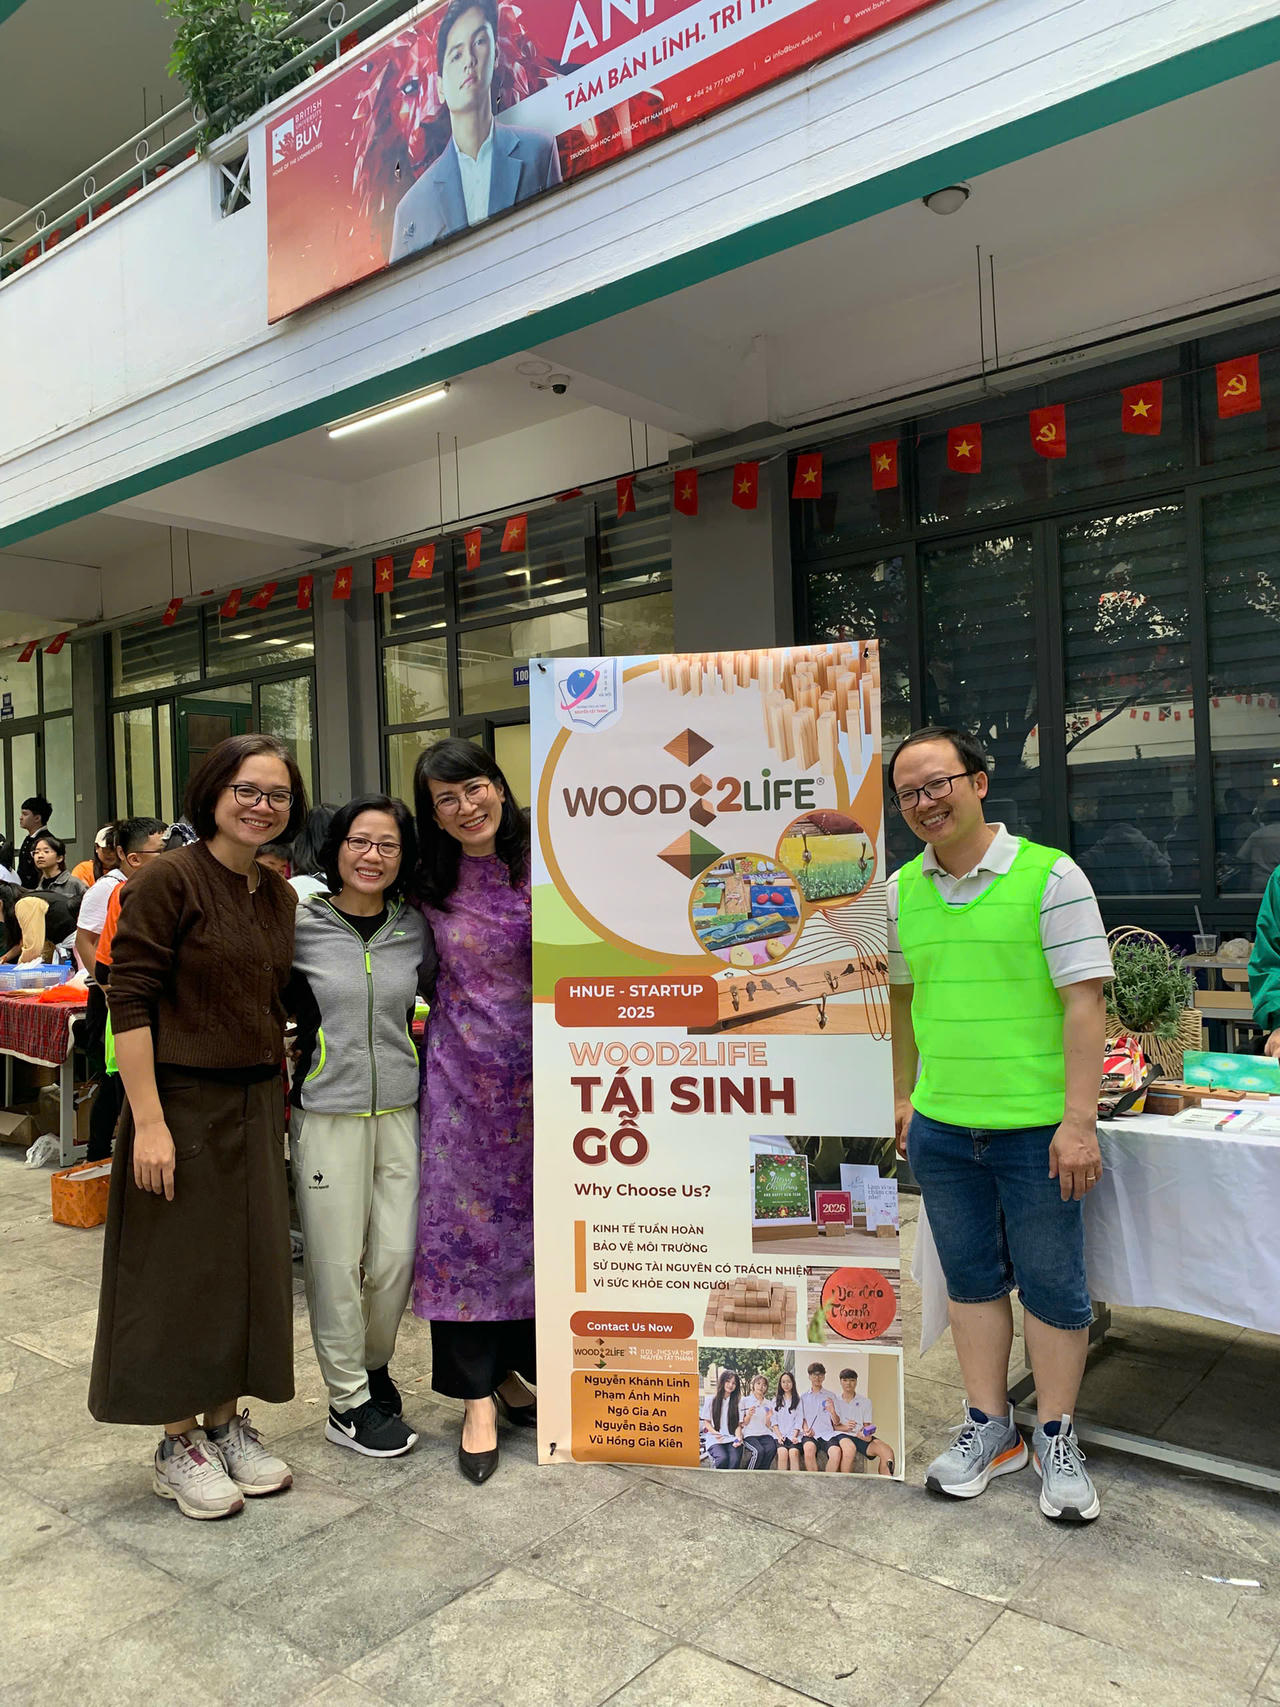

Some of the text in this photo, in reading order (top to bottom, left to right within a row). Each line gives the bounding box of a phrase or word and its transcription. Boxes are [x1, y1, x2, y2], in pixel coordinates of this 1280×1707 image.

[560, 0, 656, 66] AN
[772, 30, 822, 60] info@buv.edu.vn
[565, 75, 603, 111] TÂM
[608, 51, 647, 89] BẢN
[652, 22, 706, 66] LĨNH.
[713, 79, 724, 89] 777
[725, 73, 736, 83] 009
[295, 99, 322, 122] BRITISH
[296, 120, 322, 151] BUV
[563, 784, 687, 818] WOOD
[569, 985, 615, 998] HNUE
[629, 984, 704, 997] STARTUP
[617, 1006, 655, 1019] 2025
[568, 1041, 768, 1067] WOOD2LIFE
[570, 1066, 797, 1116] TÁI SINH
[572, 1110, 650, 1166] GỖ
[574, 1183, 711, 1199] Why Choose Us?
[823, 1203, 846, 1213] 2026
[593, 1224, 619, 1233] KINH
[622, 1222, 635, 1234] TẾ
[672, 1224, 704, 1235] HOÀN
[593, 1240, 708, 1253] BẢO VỆ MÔI TRƯỜNG
[593, 1259, 813, 1277] SỬ DỤNG TÀI NGUYÊN CÓ TRÁCH NHIỆM
[593, 1277, 730, 1290] VÌ SỨC KHỎE CON NGƯỜI
[586, 1321, 673, 1333] Contact Us Now
[574, 1348, 600, 1356] WOOD
[584, 1374, 690, 1388] Nguyễn Khánh Linh
[594, 1390, 680, 1402] Phạm Ánh Minh
[607, 1405, 667, 1417] Ngô Gia An
[594, 1420, 683, 1433] Nguyễn Bảo Sơn
[589, 1435, 683, 1448] Vũ Hồng Gia Kiên
